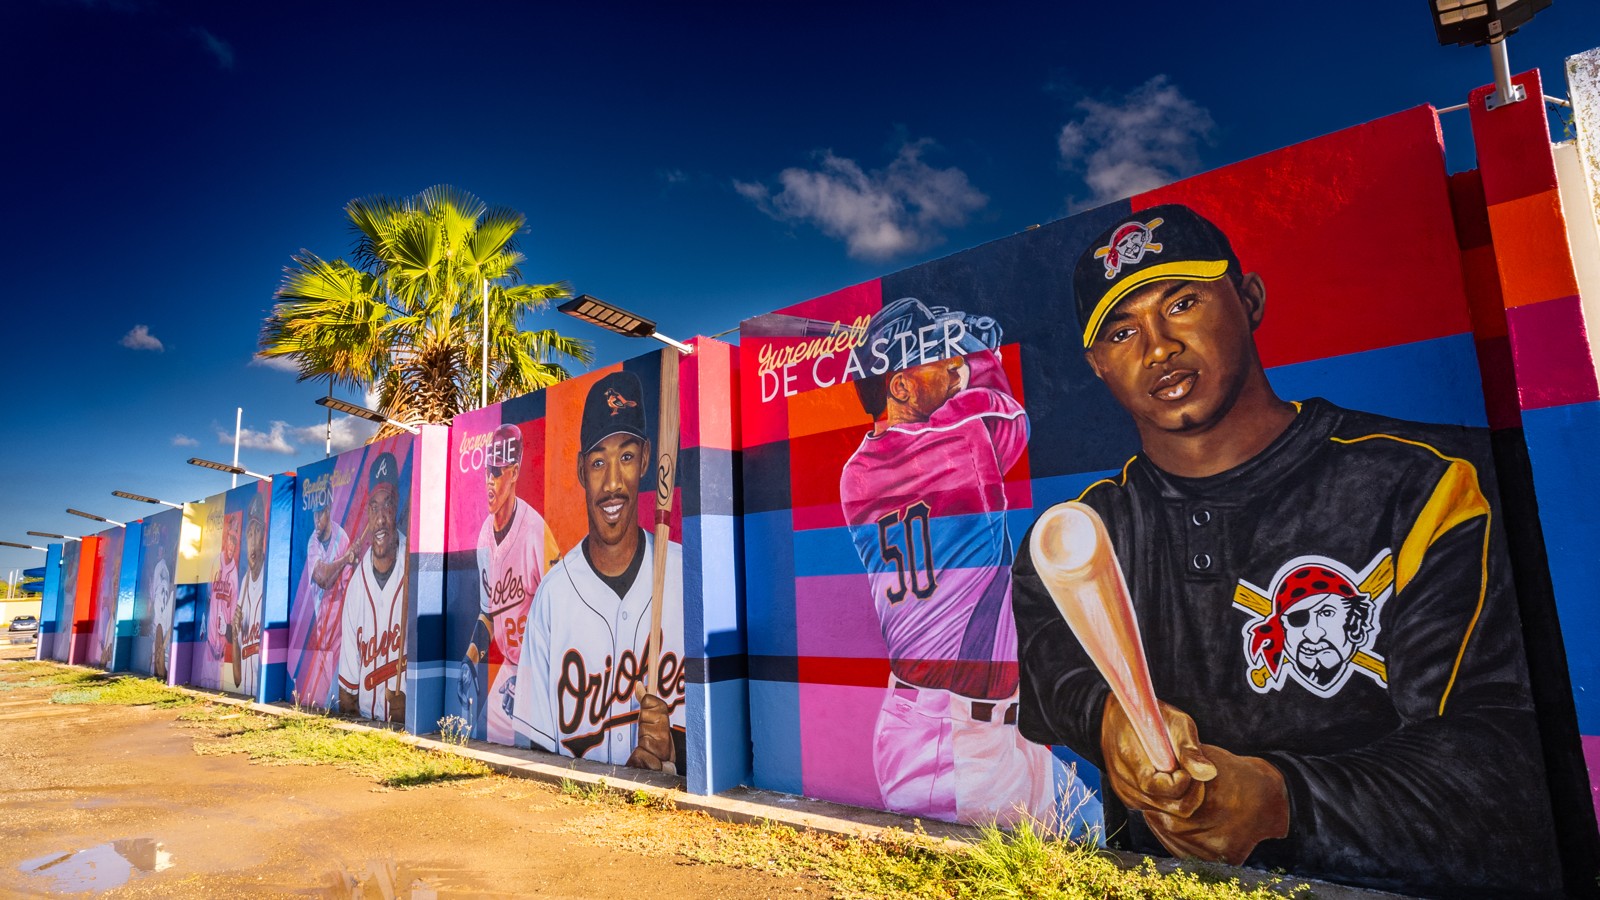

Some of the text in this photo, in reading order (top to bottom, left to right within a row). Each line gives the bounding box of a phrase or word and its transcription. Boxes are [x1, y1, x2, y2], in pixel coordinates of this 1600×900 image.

[761, 319, 968, 403] DE CASTER
[460, 437, 516, 473] COFFIE
[302, 487, 334, 511] SIMON
[878, 500, 938, 608] 50
[357, 623, 401, 668] rave
